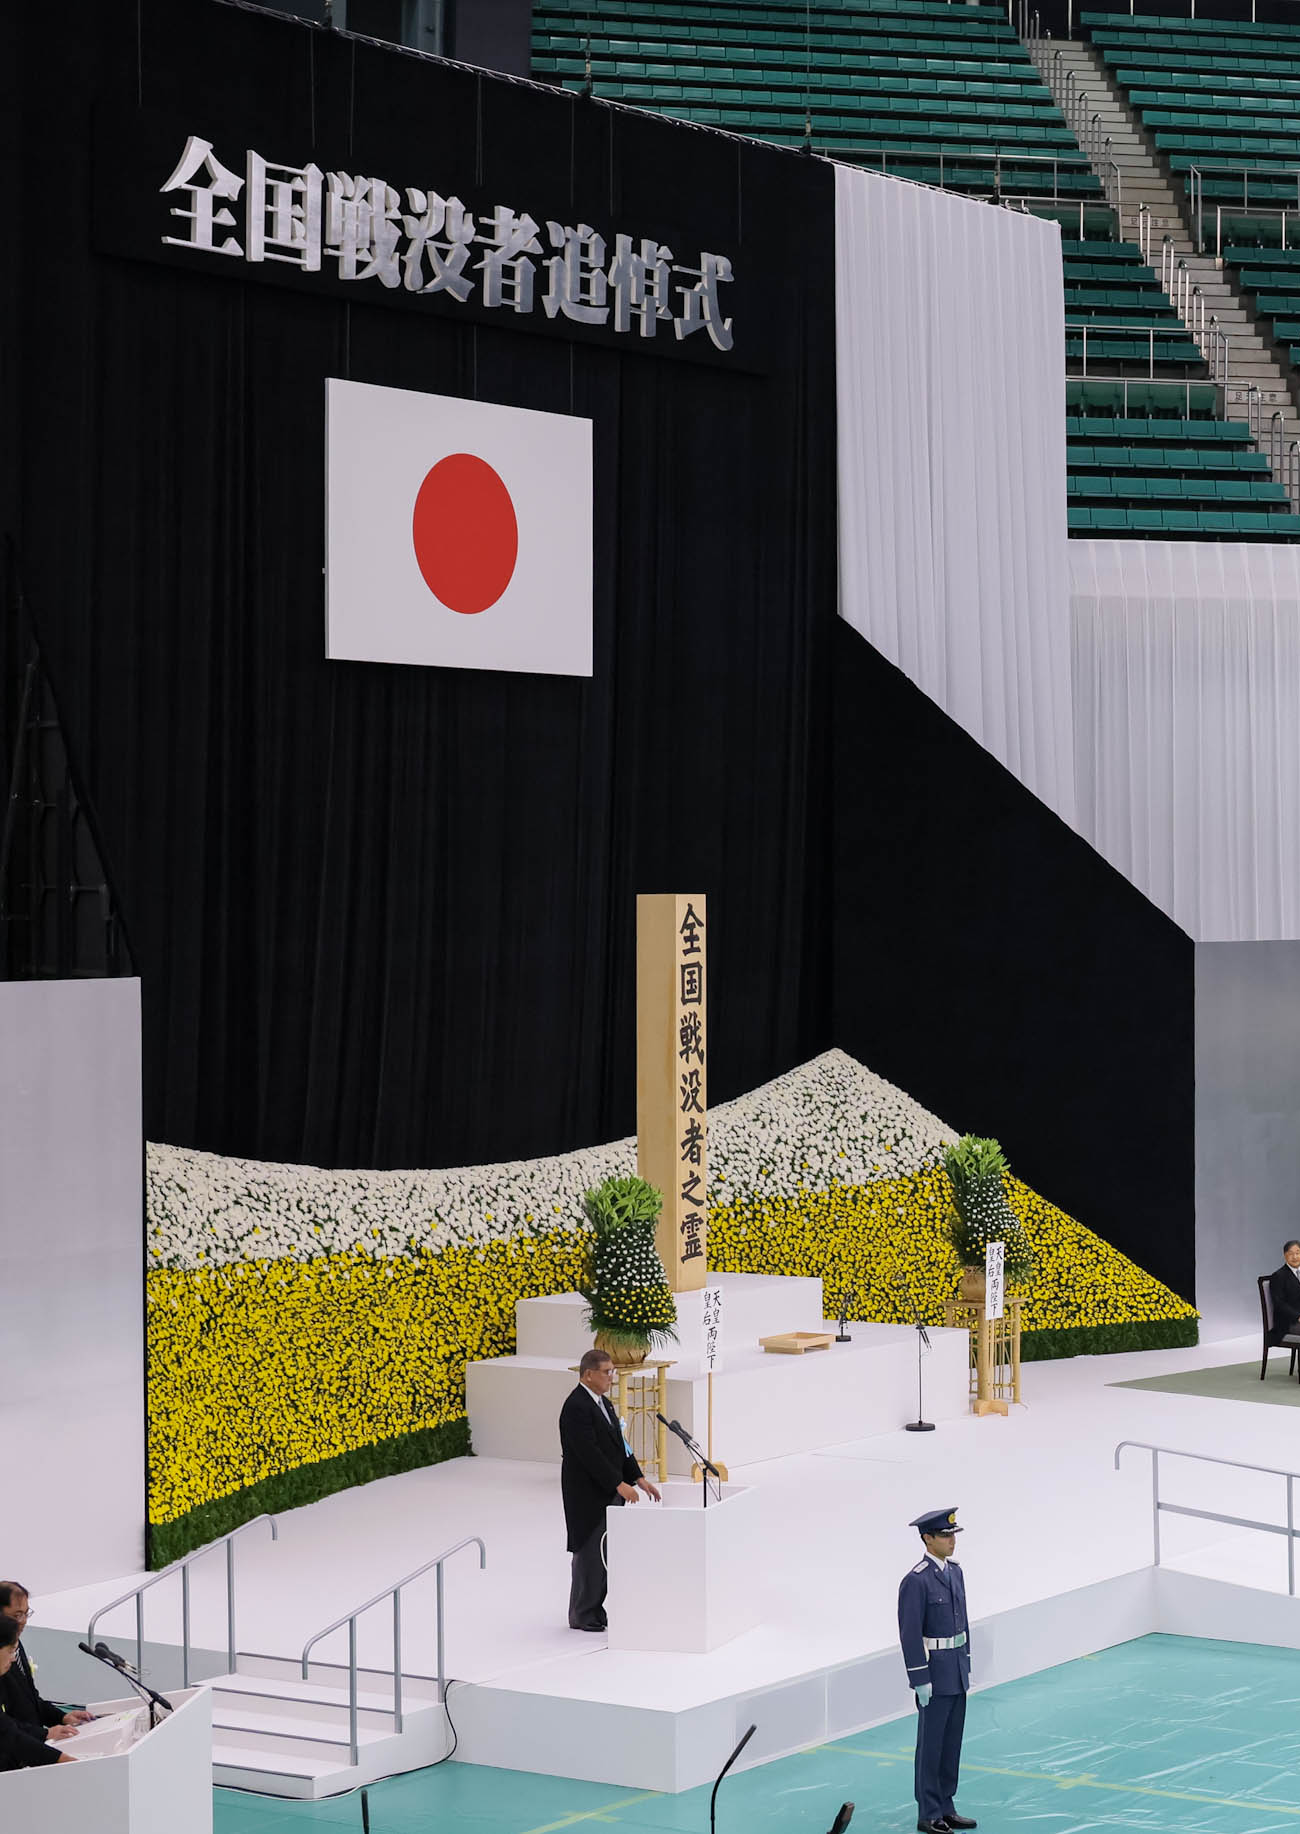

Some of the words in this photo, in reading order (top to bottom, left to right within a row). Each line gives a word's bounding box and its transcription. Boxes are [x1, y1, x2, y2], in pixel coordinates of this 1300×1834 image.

[160, 136, 734, 351] 全国戦没者追悼式
[679, 903, 705, 1265] 全国戦没者之霊
